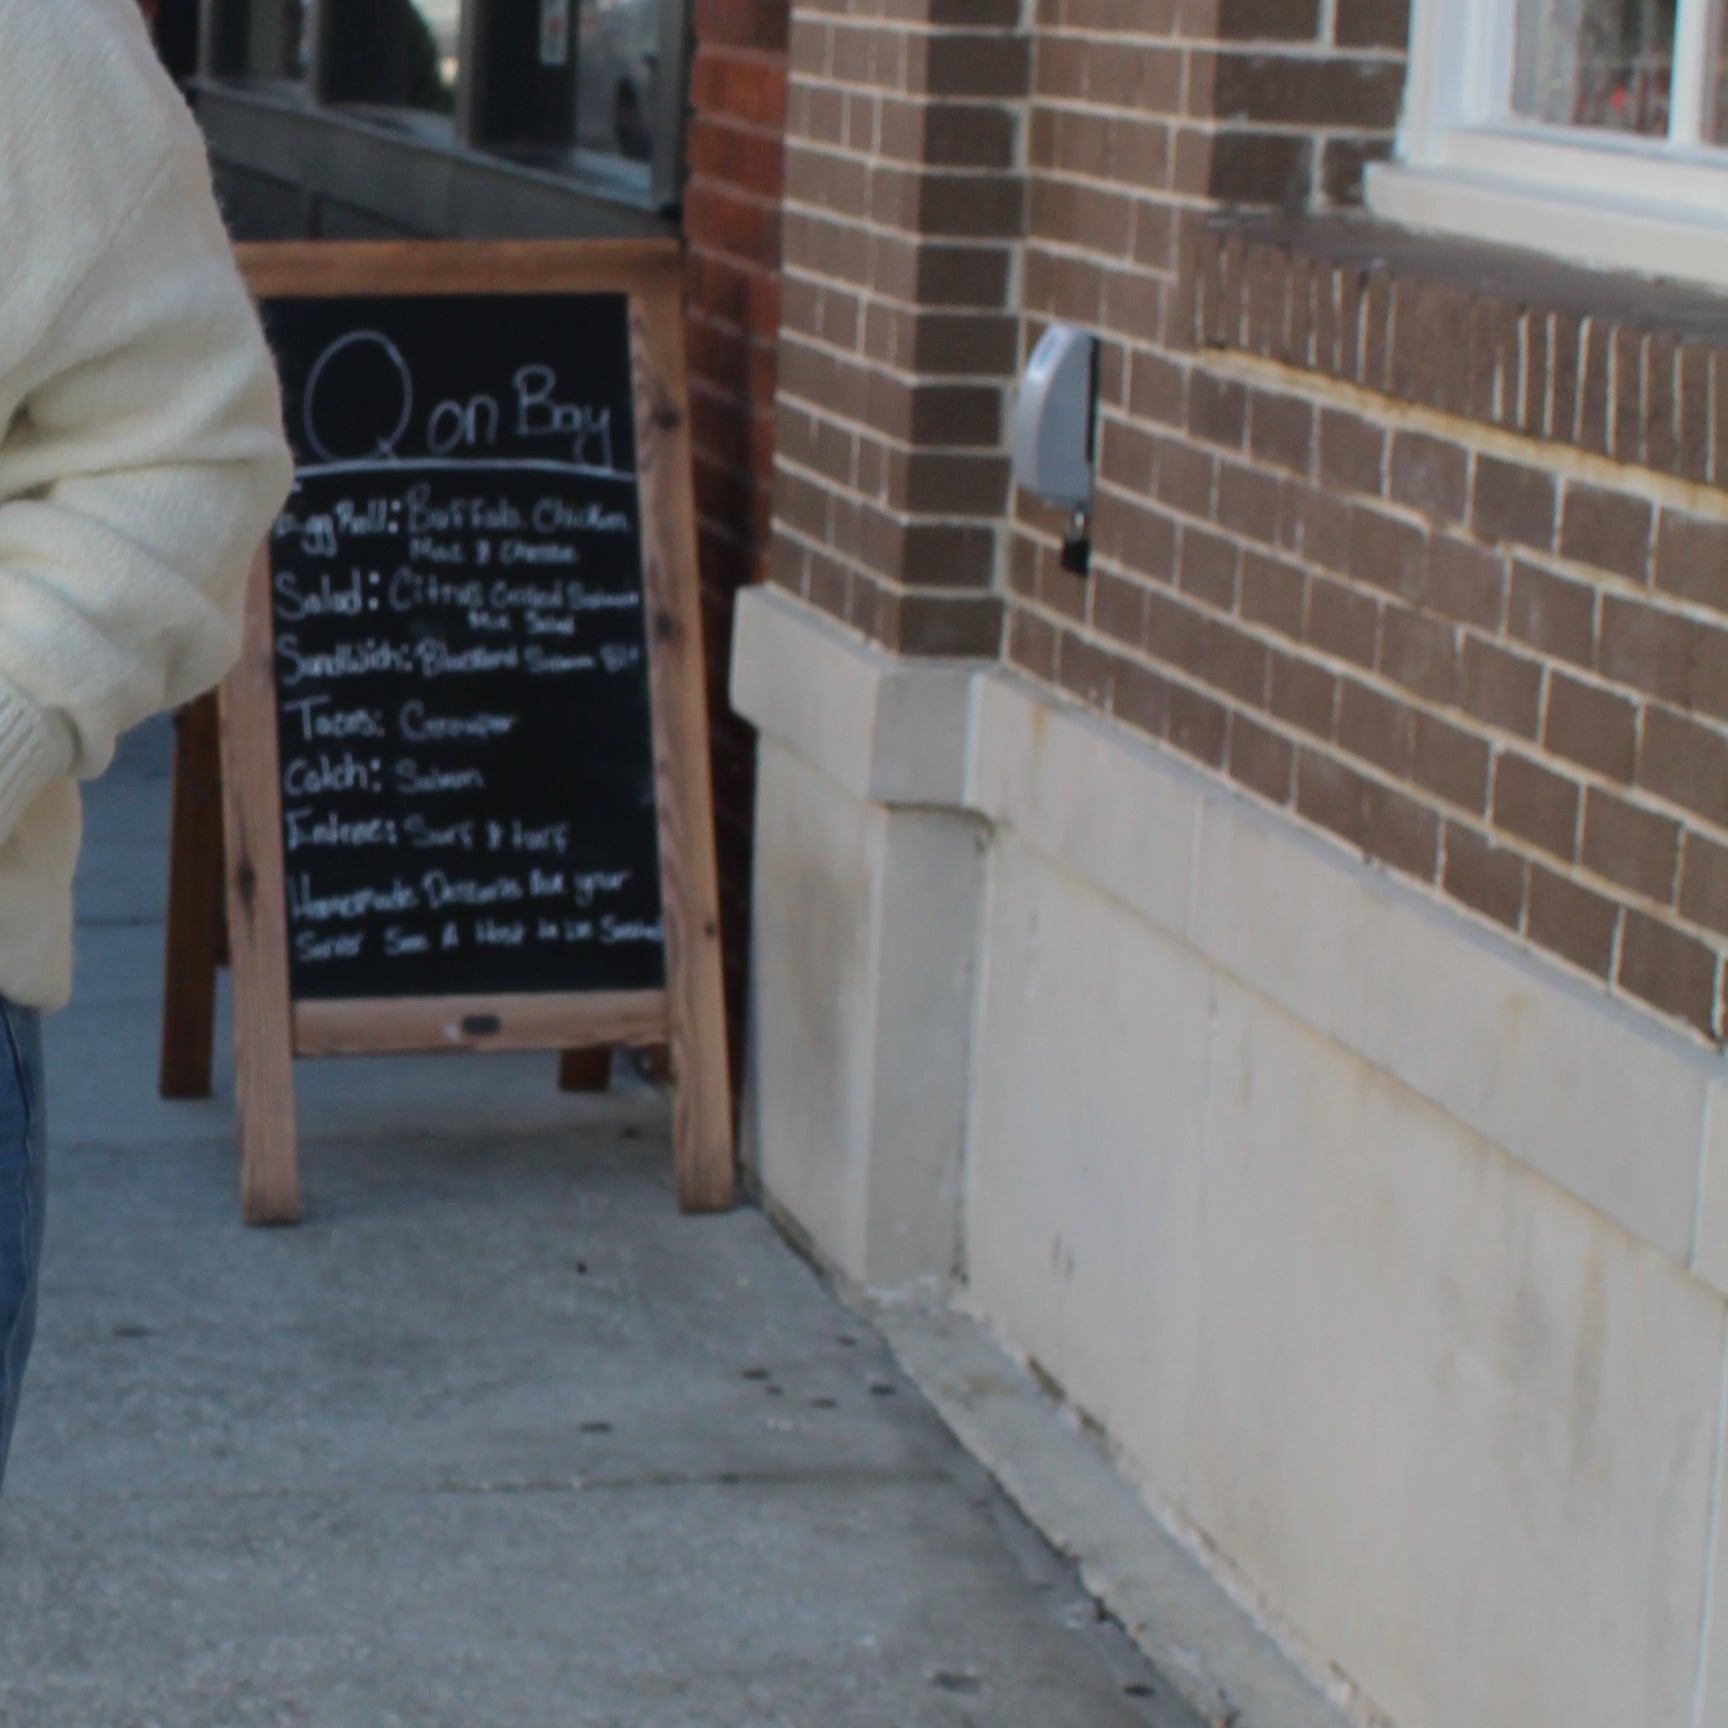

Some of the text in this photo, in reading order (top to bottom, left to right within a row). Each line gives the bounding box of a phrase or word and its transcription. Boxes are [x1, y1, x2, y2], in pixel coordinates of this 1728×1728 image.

[304, 329, 613, 472] Q on Bay
[406, 479, 522, 534] Buffalo
[532, 497, 631, 534] Chicken
[274, 568, 381, 621] Salad:
[388, 566, 484, 612] Citrus
[283, 693, 385, 742] Tacos:
[284, 751, 382, 796] Catch:
